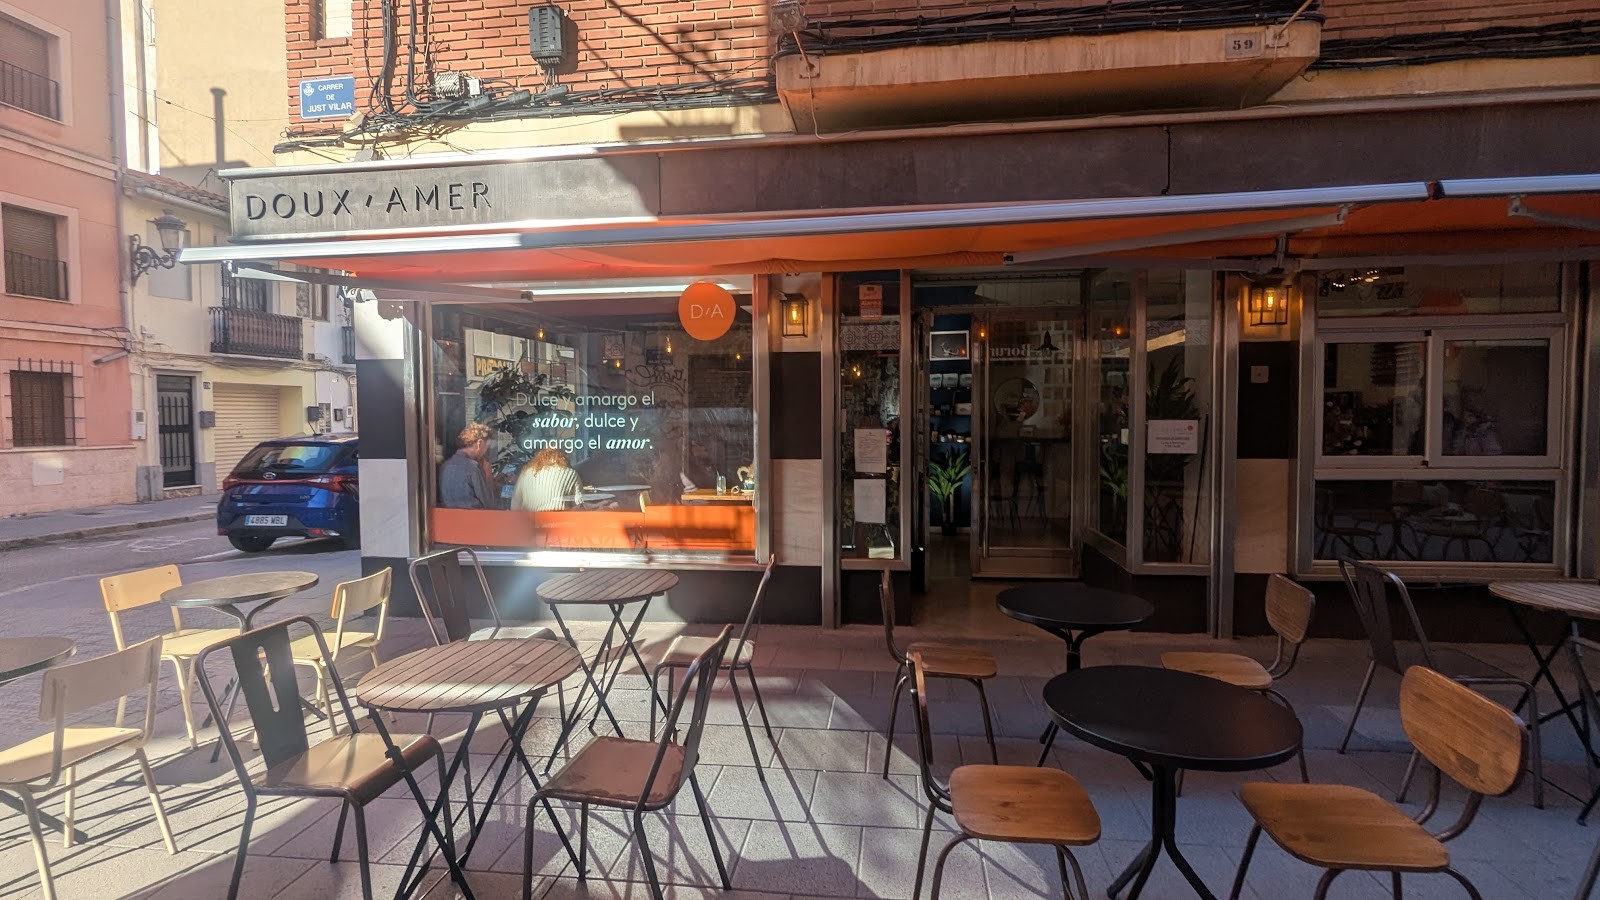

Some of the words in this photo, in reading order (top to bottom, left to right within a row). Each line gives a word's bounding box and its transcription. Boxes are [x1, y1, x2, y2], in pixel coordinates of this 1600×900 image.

[1232, 39, 1253, 50] 59
[318, 83, 344, 92] CARRER
[307, 104, 327, 113] JUST
[328, 102, 352, 111] VILAR
[246, 189, 352, 220] DOUX
[386, 181, 493, 214] AMER
[516, 390, 559, 407] Dulce
[561, 395, 572, 410] y
[575, 394, 638, 410] amargo
[641, 390, 655, 406] el
[532, 413, 580, 430] sabor,
[584, 412, 626, 428] dulce
[629, 416, 639, 431] y
[523, 438, 584, 453] amargo
[588, 434, 601, 449] el
[605, 438, 653, 449] amor.
